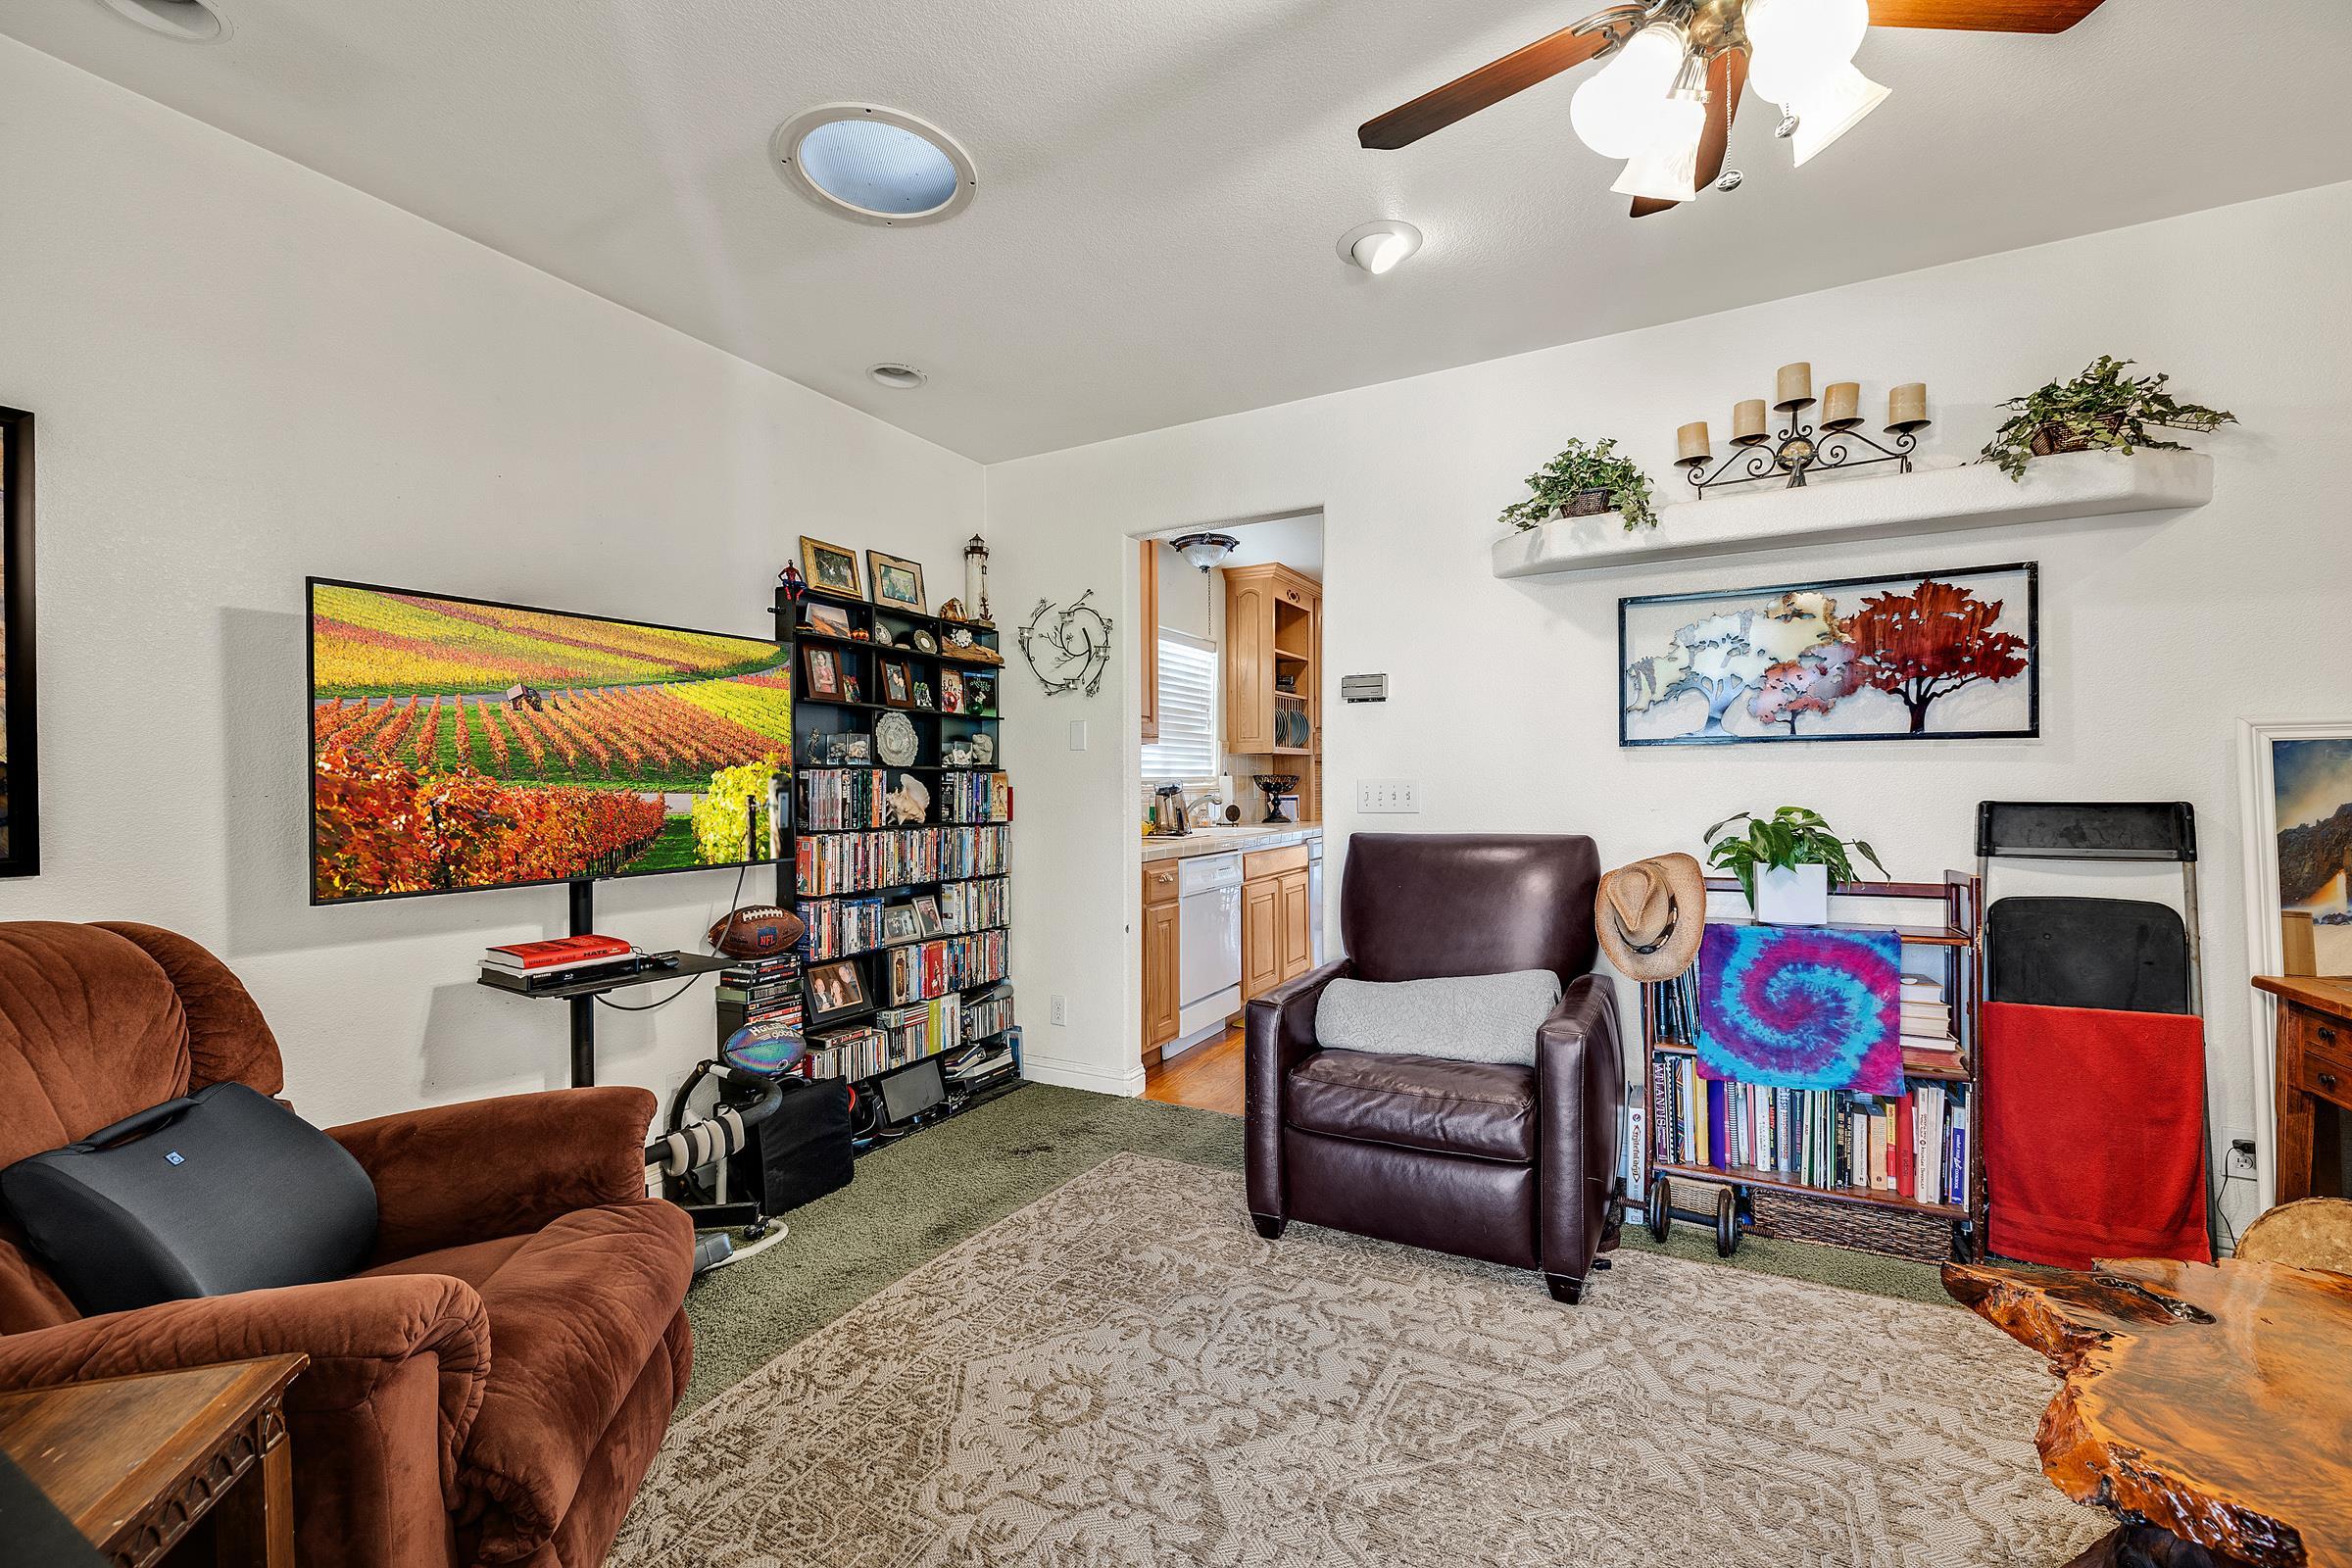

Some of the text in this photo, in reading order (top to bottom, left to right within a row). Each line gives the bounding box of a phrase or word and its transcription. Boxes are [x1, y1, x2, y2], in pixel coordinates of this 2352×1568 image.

[760, 935, 775, 946] NFL
[584, 949, 608, 957] HATE
[1654, 1063, 1666, 1128] ATLANTIS
